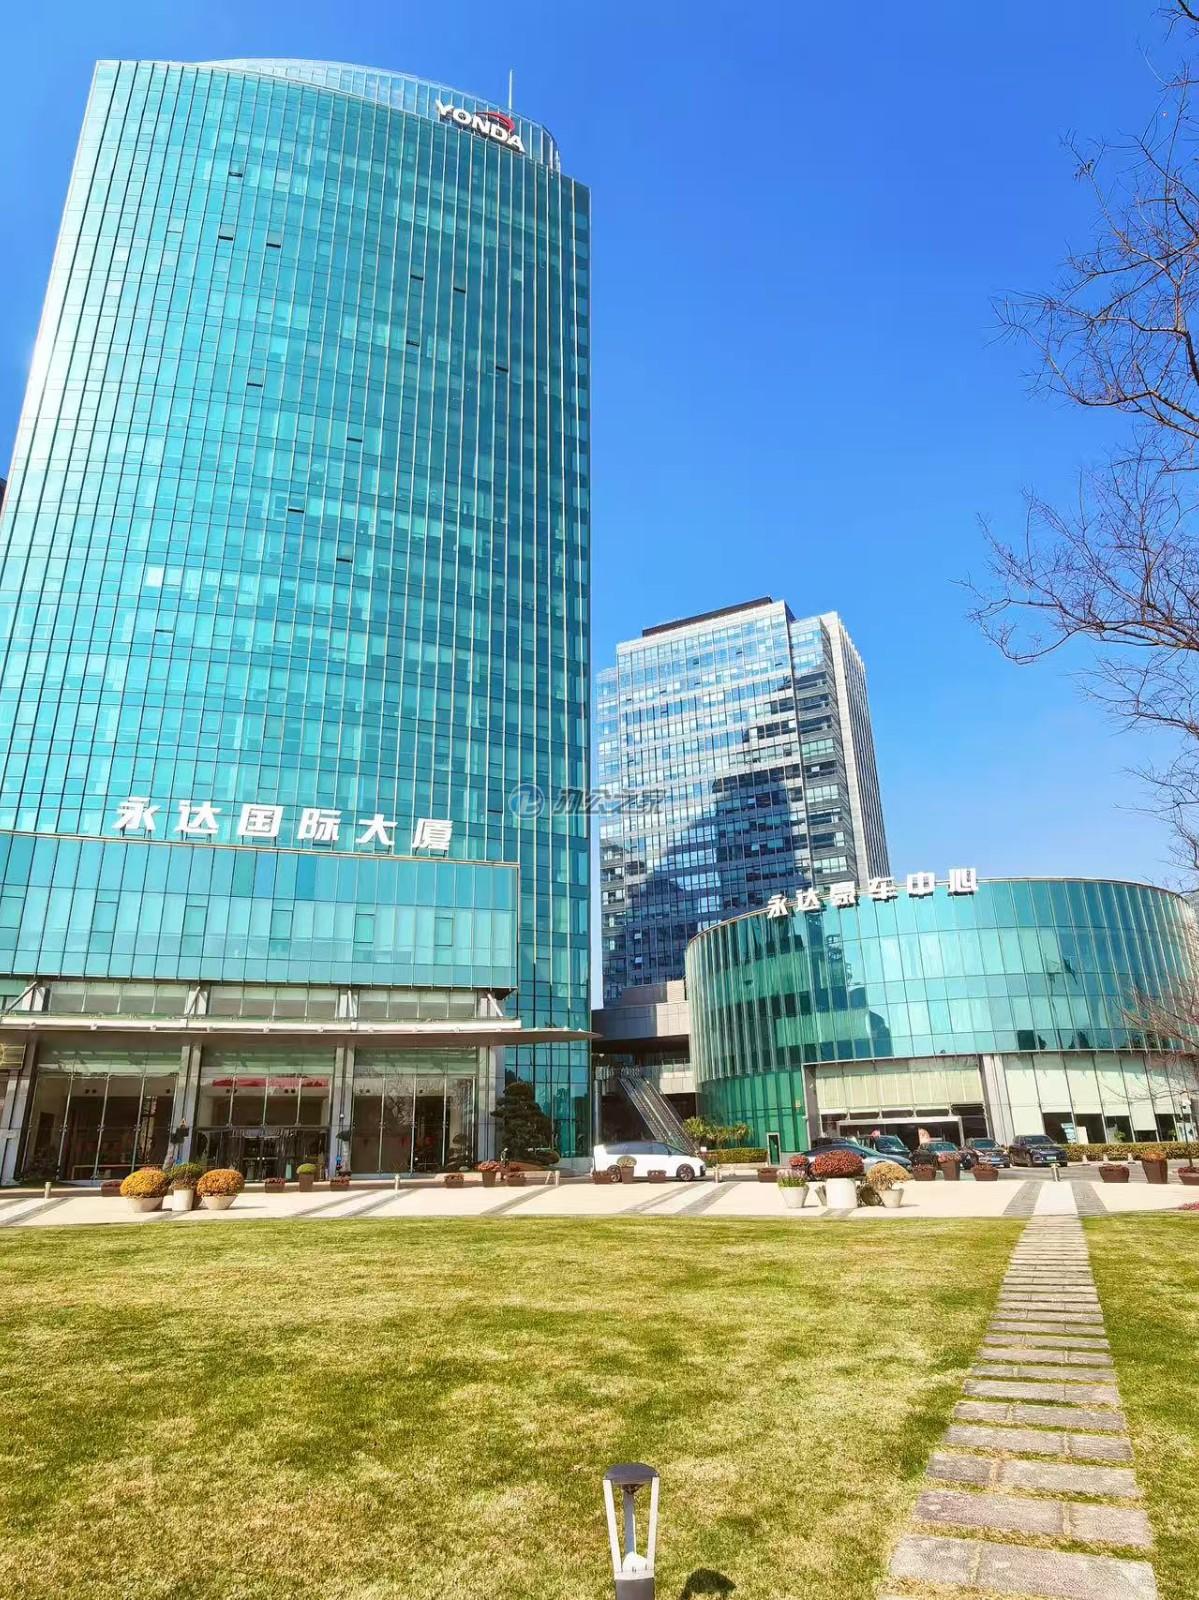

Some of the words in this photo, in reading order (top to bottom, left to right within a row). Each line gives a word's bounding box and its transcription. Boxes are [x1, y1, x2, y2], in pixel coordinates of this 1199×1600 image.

[435, 99, 526, 153] YONDA
[112, 796, 453, 851] 永达国际大厦
